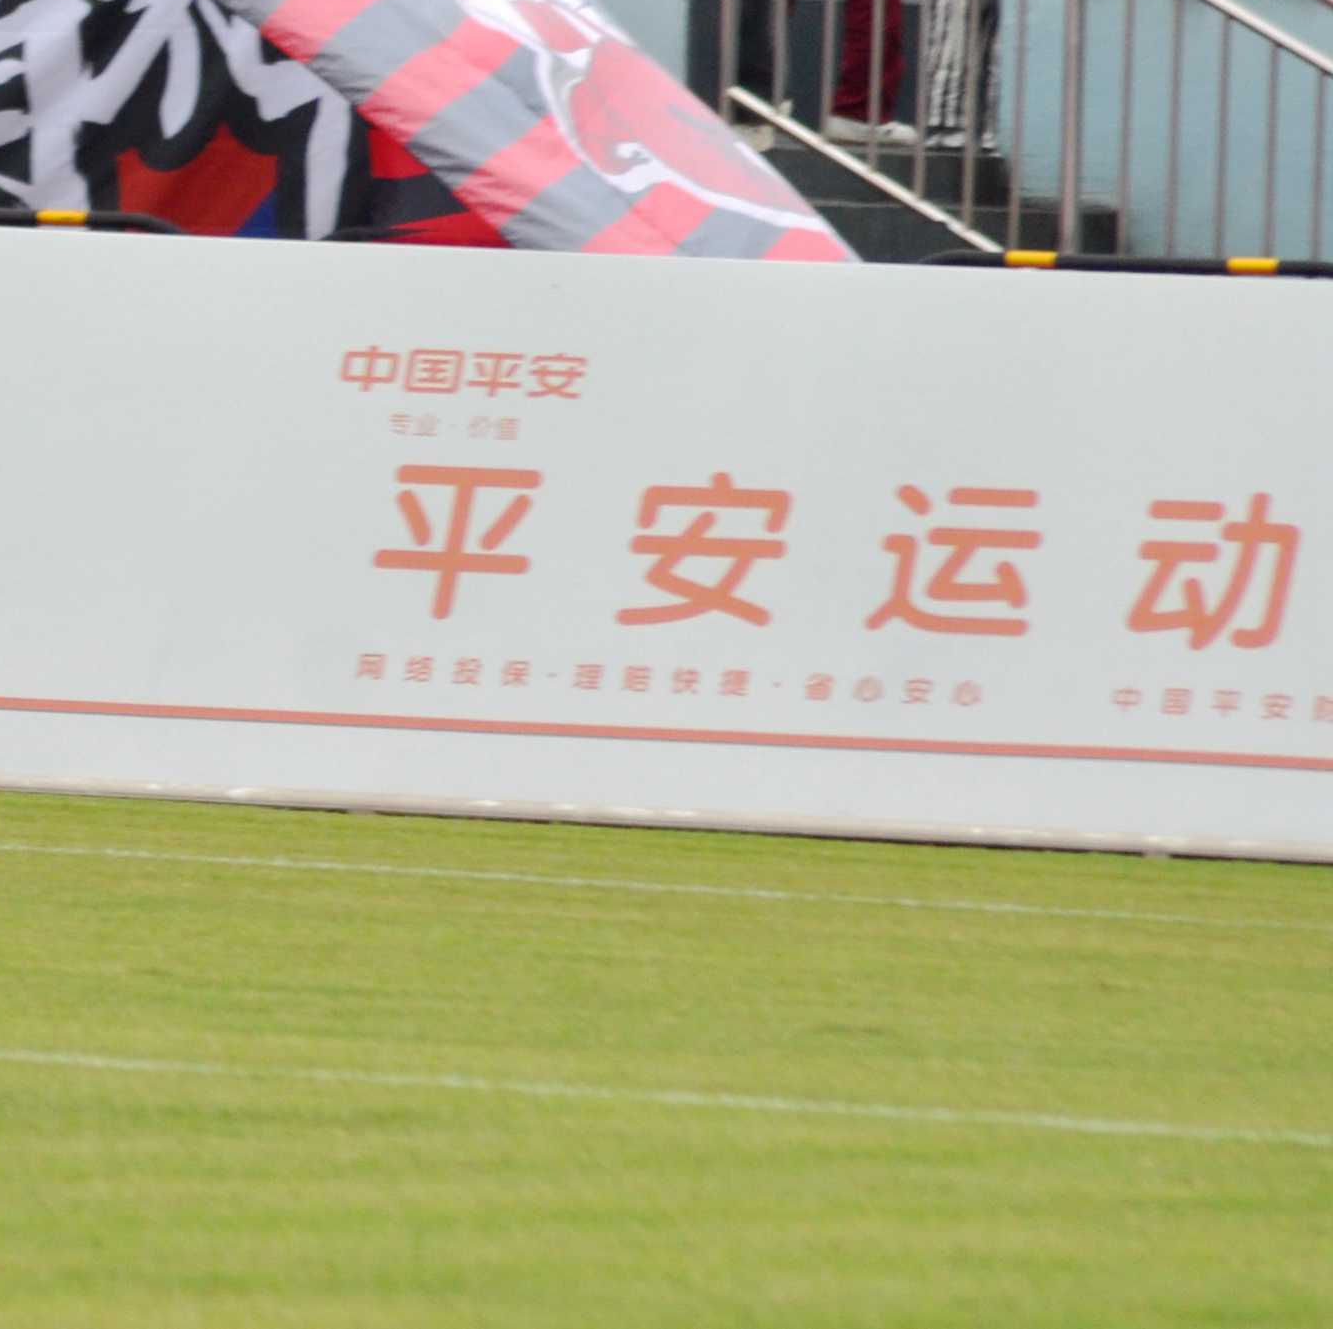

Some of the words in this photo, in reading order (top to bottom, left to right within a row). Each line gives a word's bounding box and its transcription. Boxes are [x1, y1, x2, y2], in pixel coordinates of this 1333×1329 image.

[339, 345, 588, 400] 中国平安
[372, 462, 1303, 652] 平安运动
